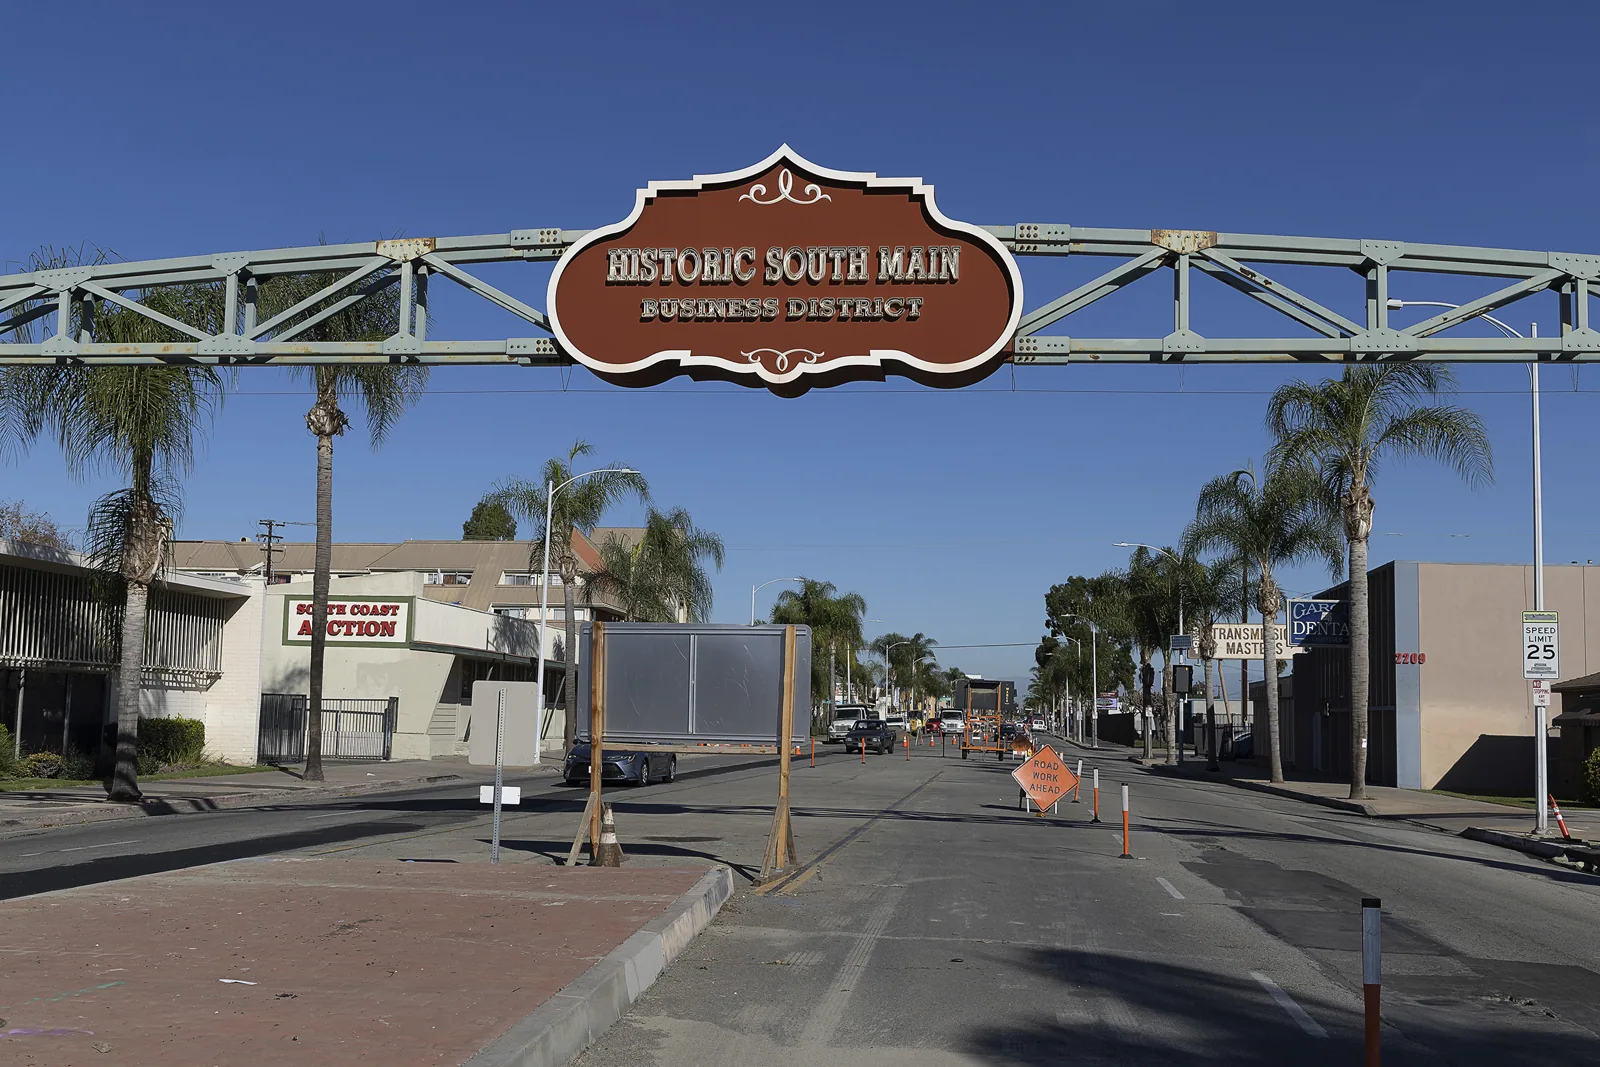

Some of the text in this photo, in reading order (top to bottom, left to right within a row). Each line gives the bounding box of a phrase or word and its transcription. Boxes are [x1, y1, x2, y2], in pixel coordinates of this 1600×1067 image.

[606, 246, 961, 282] HISTORIC SOUTH MAIN
[641, 297, 923, 318] BUSINESS DISTRICT
[296, 603, 400, 616] SOTH COAST
[297, 620, 397, 637] ACTION
[1293, 620, 1350, 636] DENTA
[1528, 635, 1553, 643] LIMIT
[1226, 642, 1283, 655] MASTES
[1527, 644, 1556, 660] 25
[1395, 652, 1426, 665] 2209
[1034, 760, 1059, 771] ROAD
[1033, 771, 1059, 783] WORK
[1029, 783, 1061, 795] AHEAD
